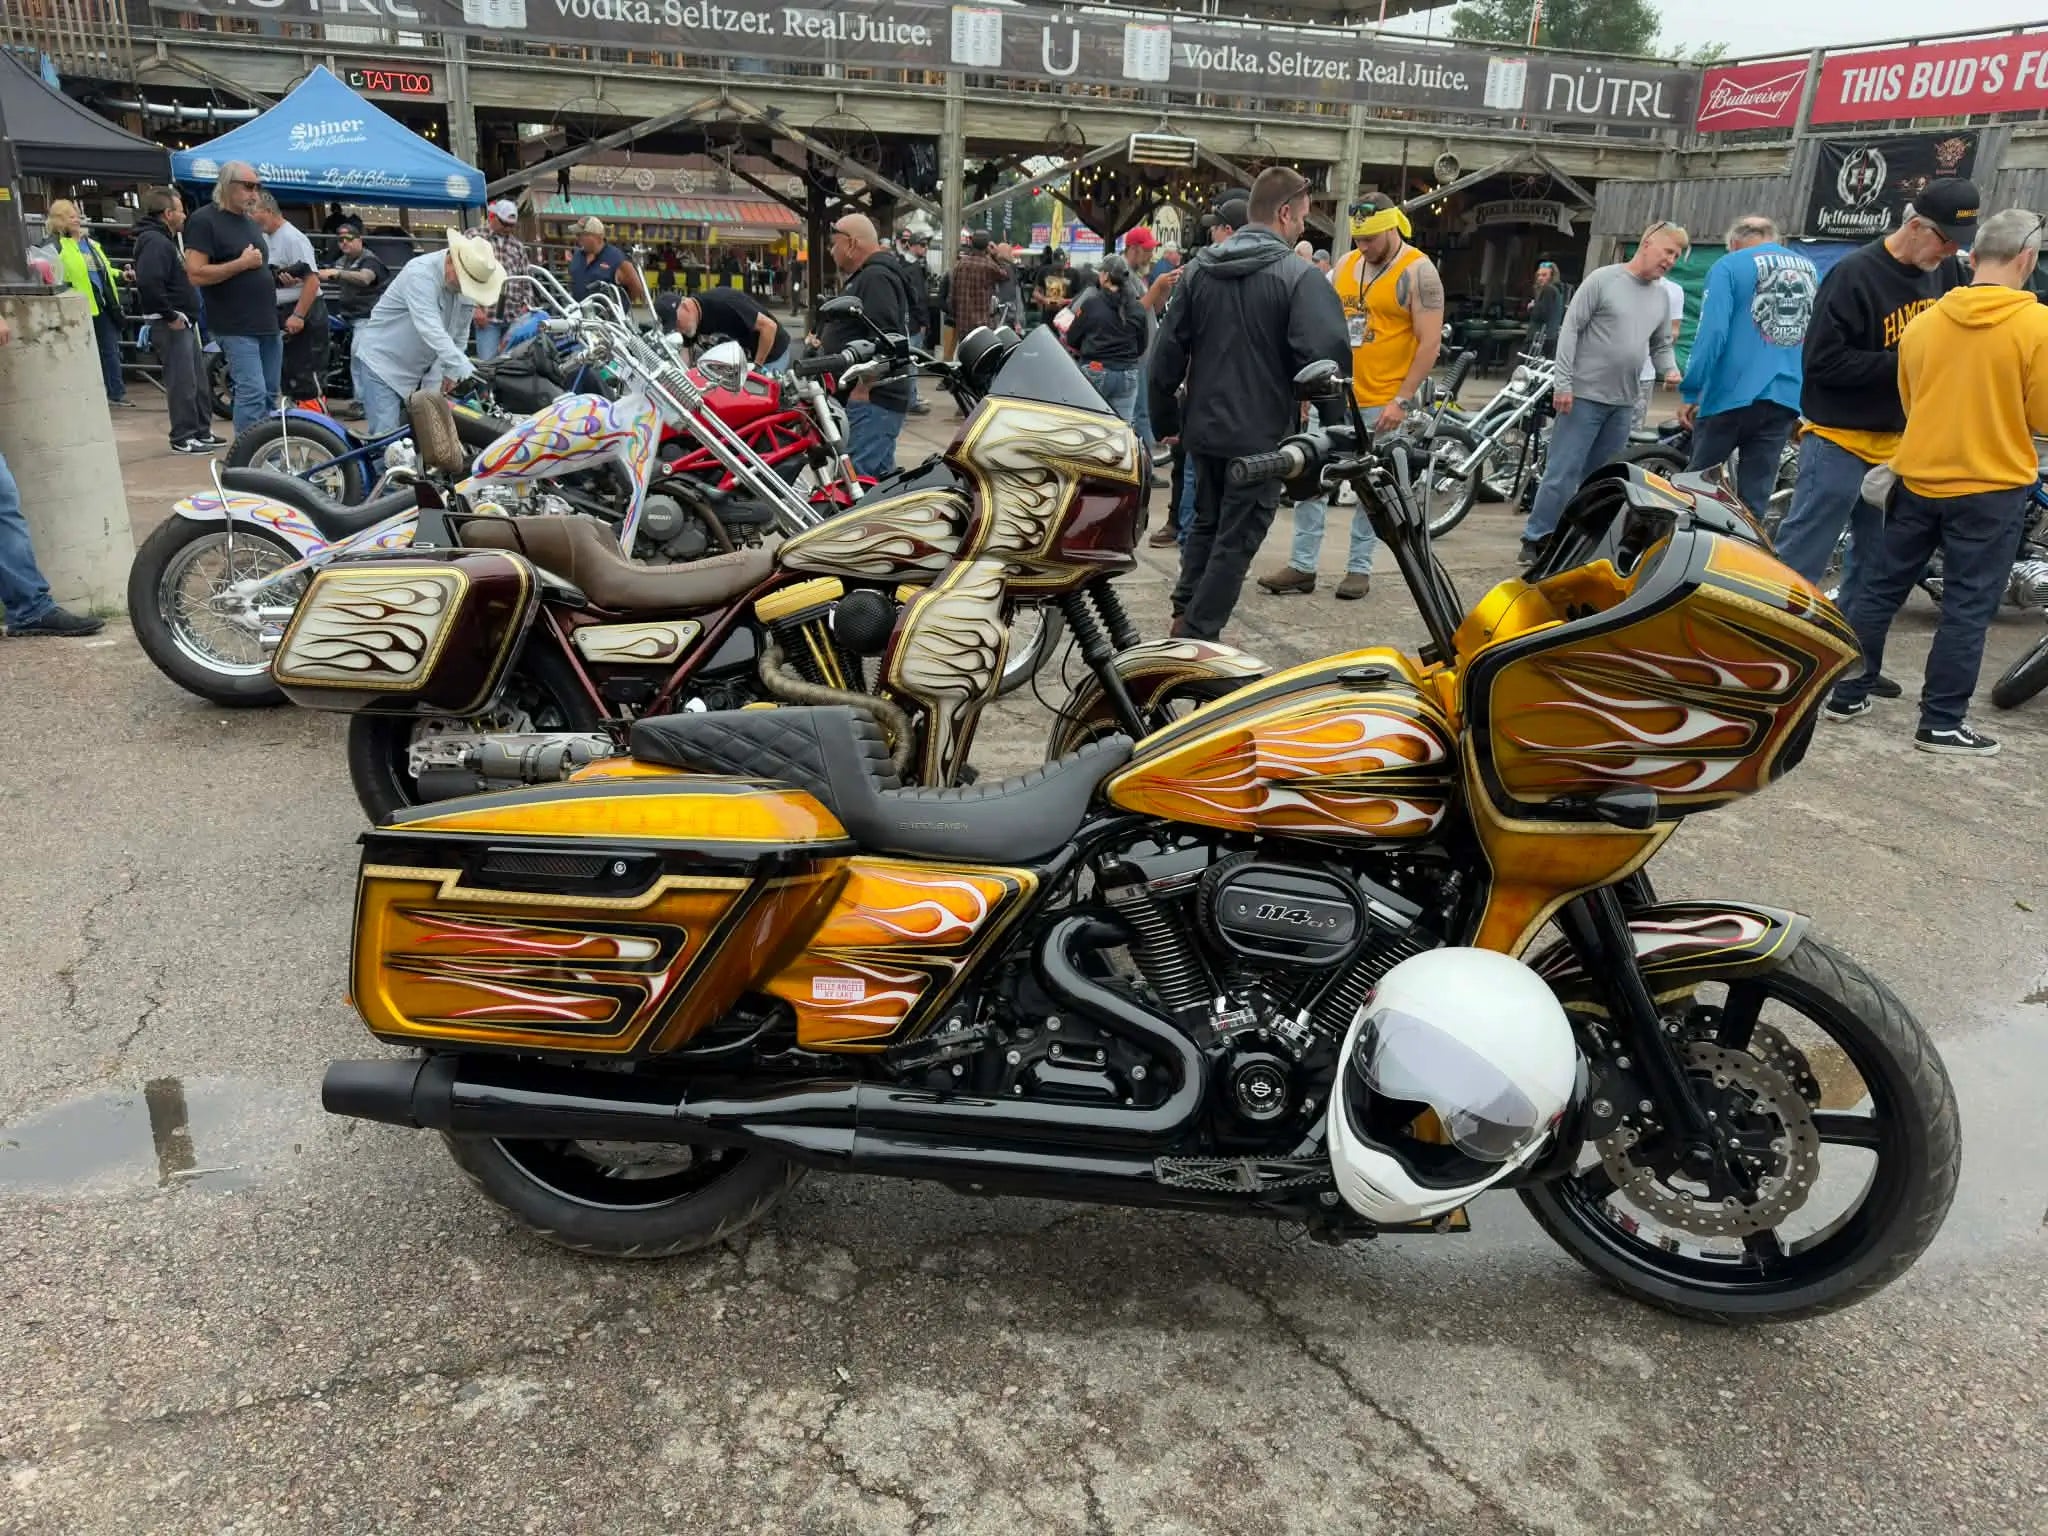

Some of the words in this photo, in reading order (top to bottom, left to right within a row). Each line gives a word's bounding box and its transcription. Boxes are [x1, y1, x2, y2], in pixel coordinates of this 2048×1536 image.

[555, 0, 661, 25] Vodka.
[663, 0, 775, 35] Seltzer.
[783, 8, 846, 41] Real
[851, 15, 933, 47] Juice.
[1042, 15, 1080, 76] Ü
[1183, 43, 1264, 74] Vodka.
[1267, 50, 1351, 81] Seltzer.
[1356, 58, 1406, 85] Real
[1407, 63, 1470, 91] Juice.
[1840, 64, 1905, 104] THIS
[1908, 54, 2008, 99] BUD'S
[361, 69, 431, 92] TATTOO
[1709, 87, 1791, 110] Budweiser
[288, 120, 365, 142] Shiner
[257, 162, 310, 184] Shiner
[317, 167, 361, 188] Light
[361, 169, 411, 187] Blonde
[1256, 904, 1312, 924] 114
